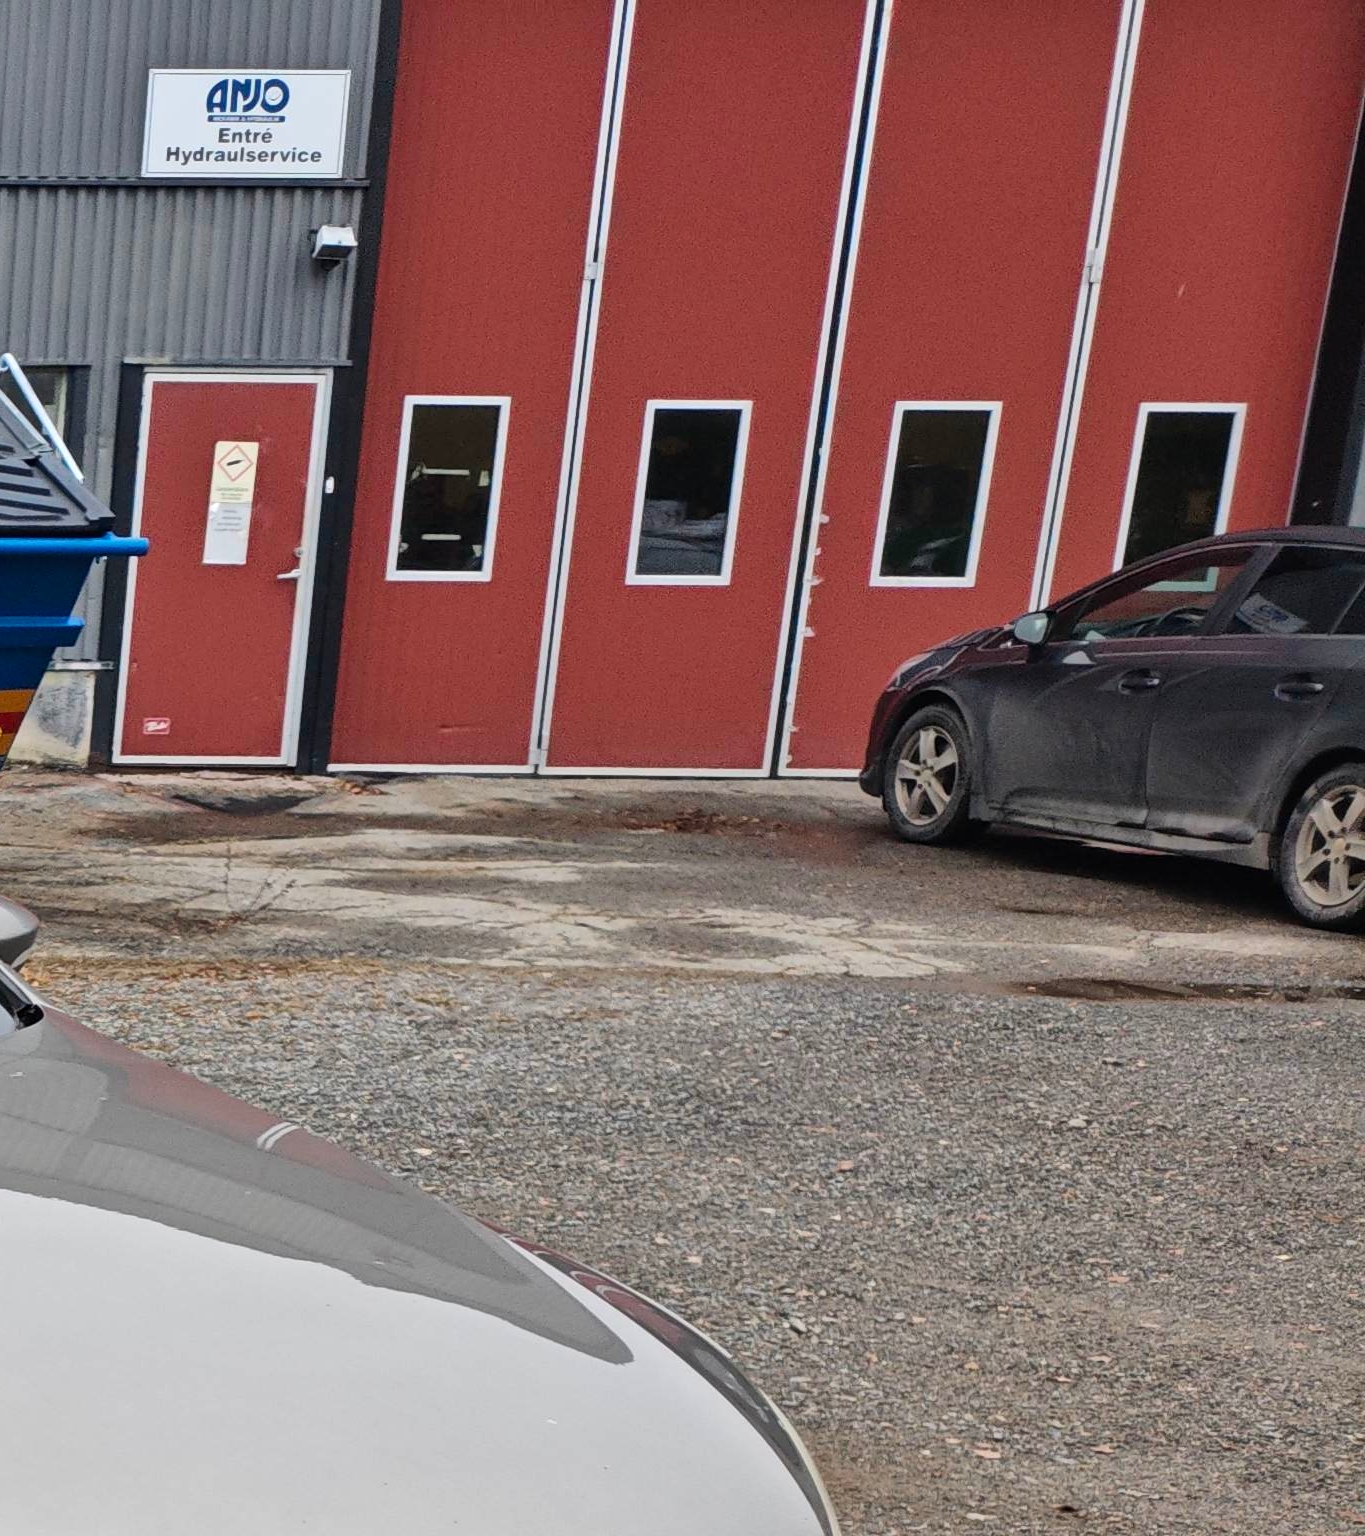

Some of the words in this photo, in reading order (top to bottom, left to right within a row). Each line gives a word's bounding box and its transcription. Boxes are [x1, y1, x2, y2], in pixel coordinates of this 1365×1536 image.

[206, 78, 290, 113] ANJO
[218, 127, 273, 144] Entré
[165, 146, 323, 166] Hydraulservice
